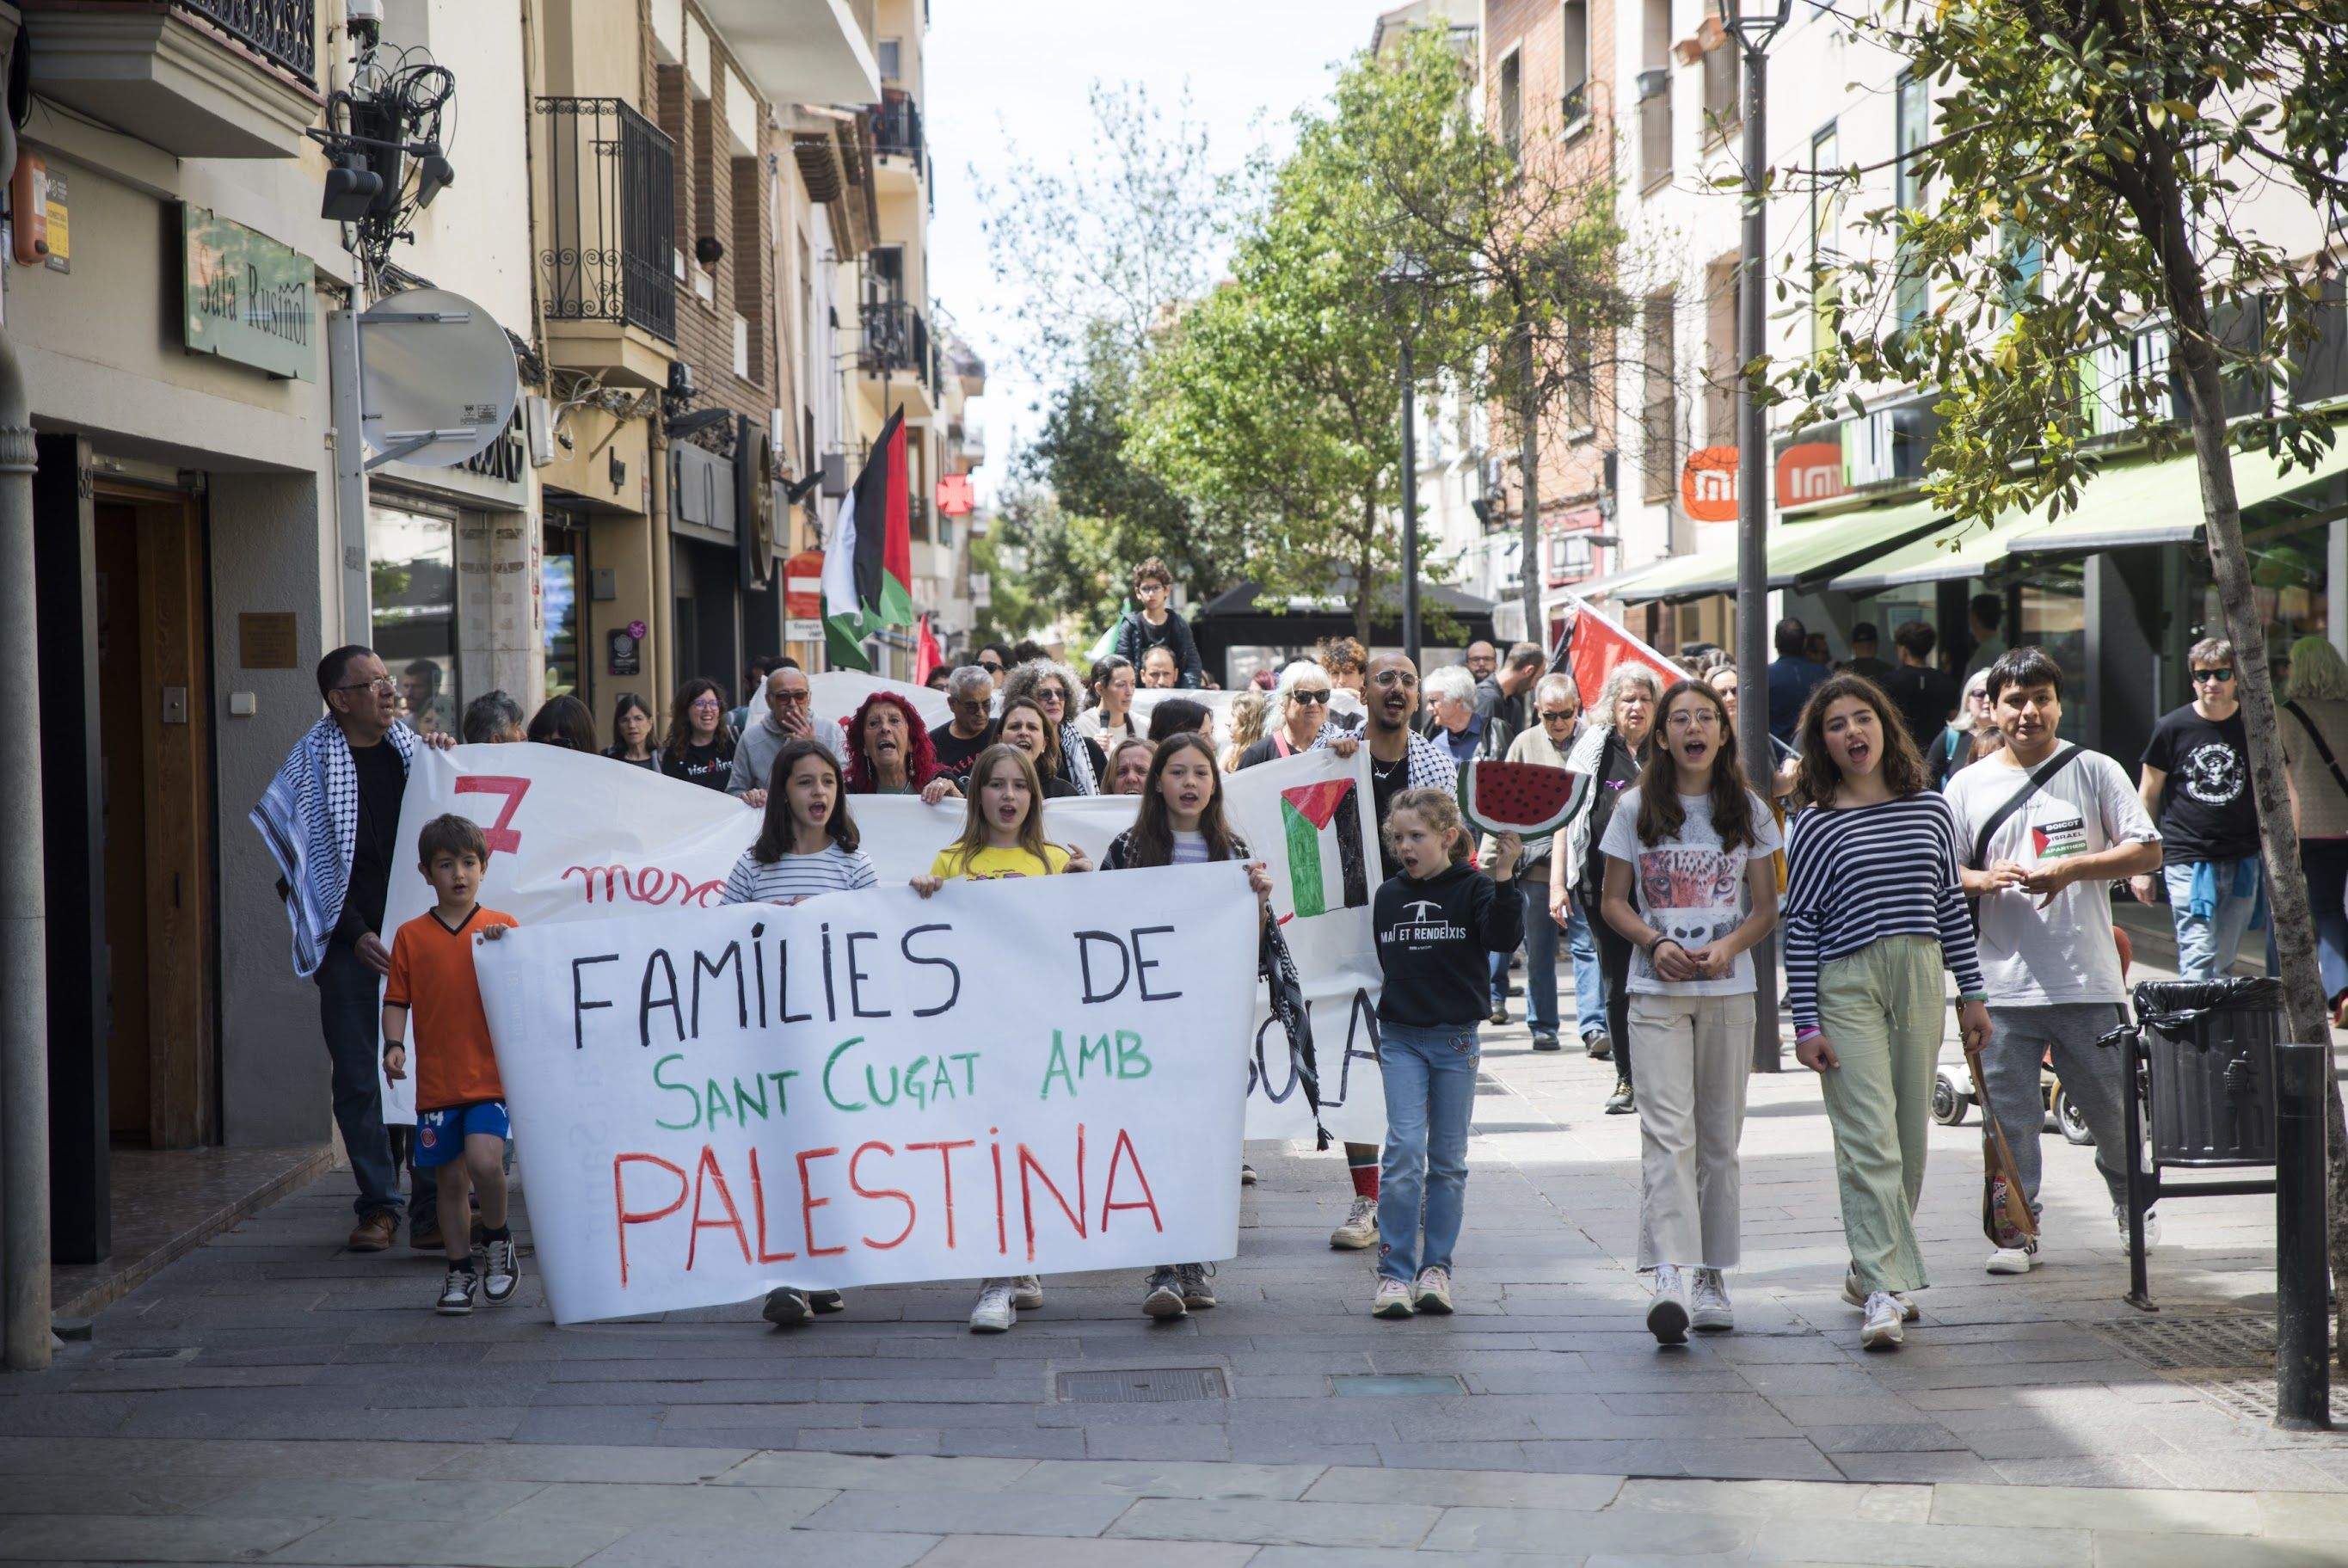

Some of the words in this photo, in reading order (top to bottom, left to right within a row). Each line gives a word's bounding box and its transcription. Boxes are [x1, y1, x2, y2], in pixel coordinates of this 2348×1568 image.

[200, 244, 237, 322] Sala
[454, 775, 531, 860] 7
[2045, 820, 2080, 831] BOICOT
[2051, 832, 2084, 842] ISRAEL
[2044, 842, 2087, 854] APARTHEID
[1380, 924, 1396, 944] MAI
[1399, 929, 1411, 941] ET
[1414, 925, 1466, 940] RENDEIXIS
[1073, 925, 1183, 1005] DE
[654, 1054, 799, 1133] SANT
[822, 1036, 980, 1112] CUGAT
[1040, 1030, 1152, 1101] AMB
[424, 1110, 444, 1126] 14
